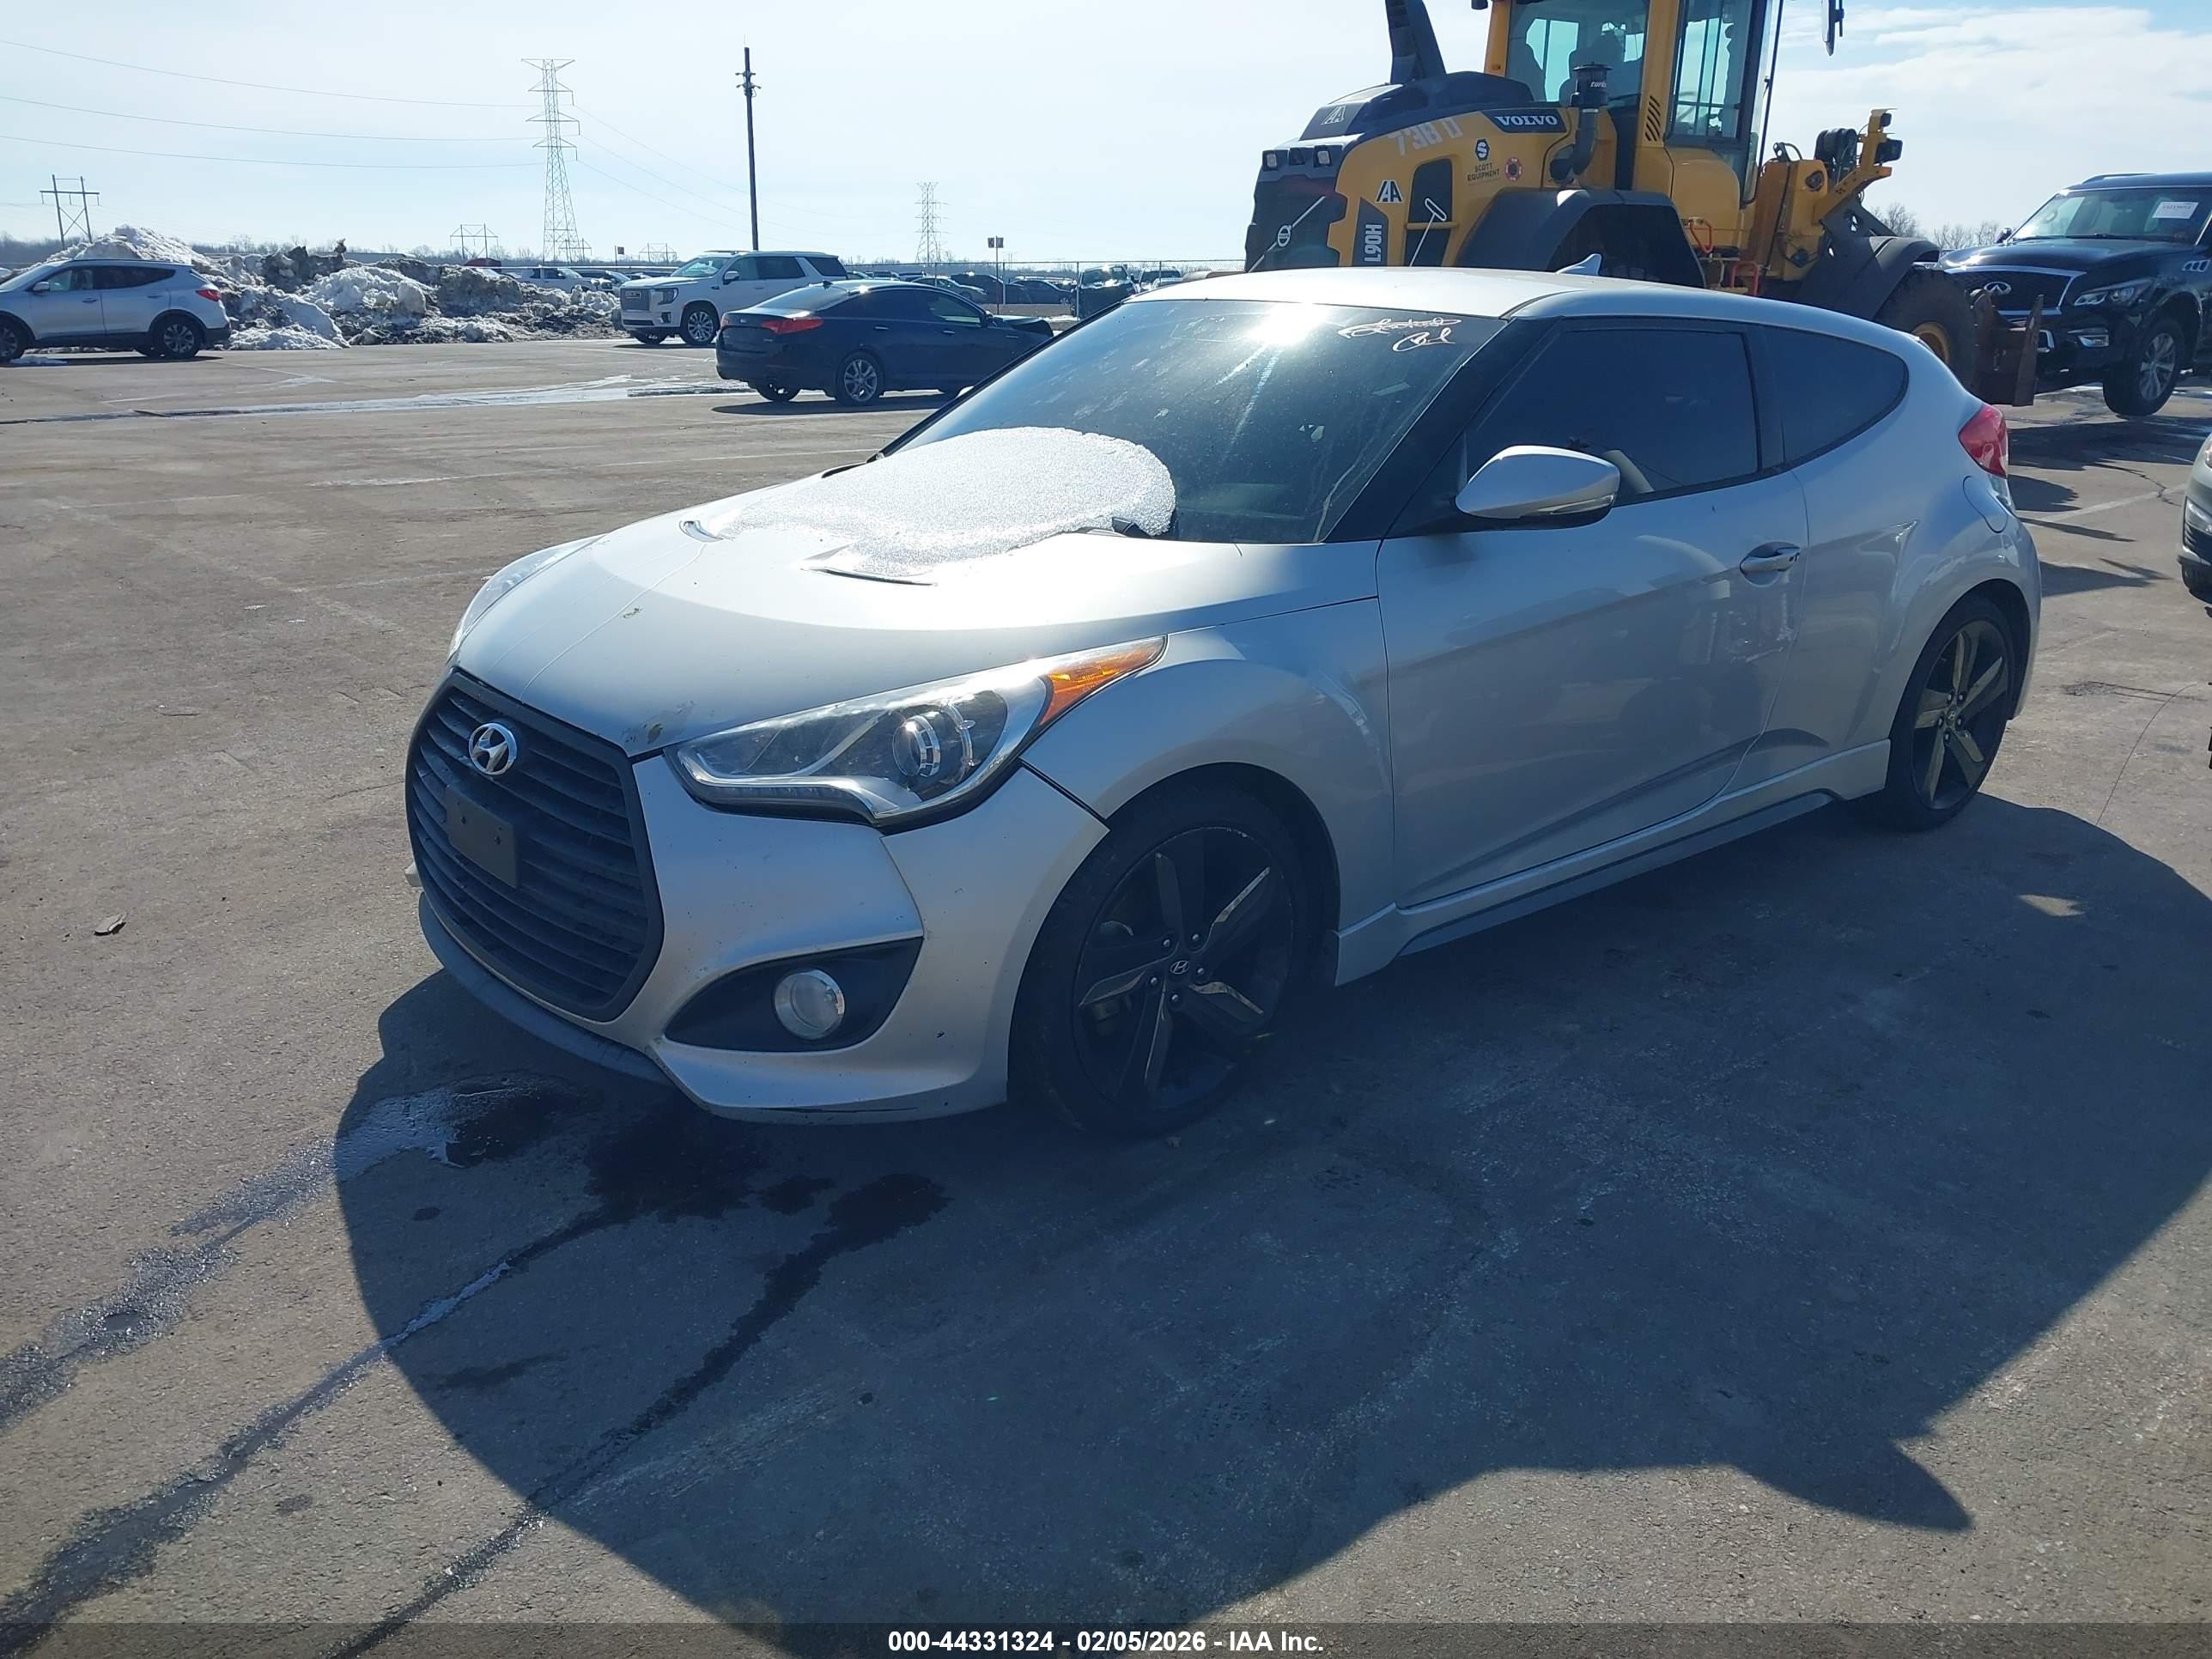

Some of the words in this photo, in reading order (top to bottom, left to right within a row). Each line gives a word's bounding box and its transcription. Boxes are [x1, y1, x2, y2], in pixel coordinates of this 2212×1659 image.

[1494, 115, 1558, 125] VOLVO
[1475, 162, 1492, 173] SCOTT
[1468, 168, 1500, 181] EQUIPMENT
[1364, 224, 1382, 262] L90H
